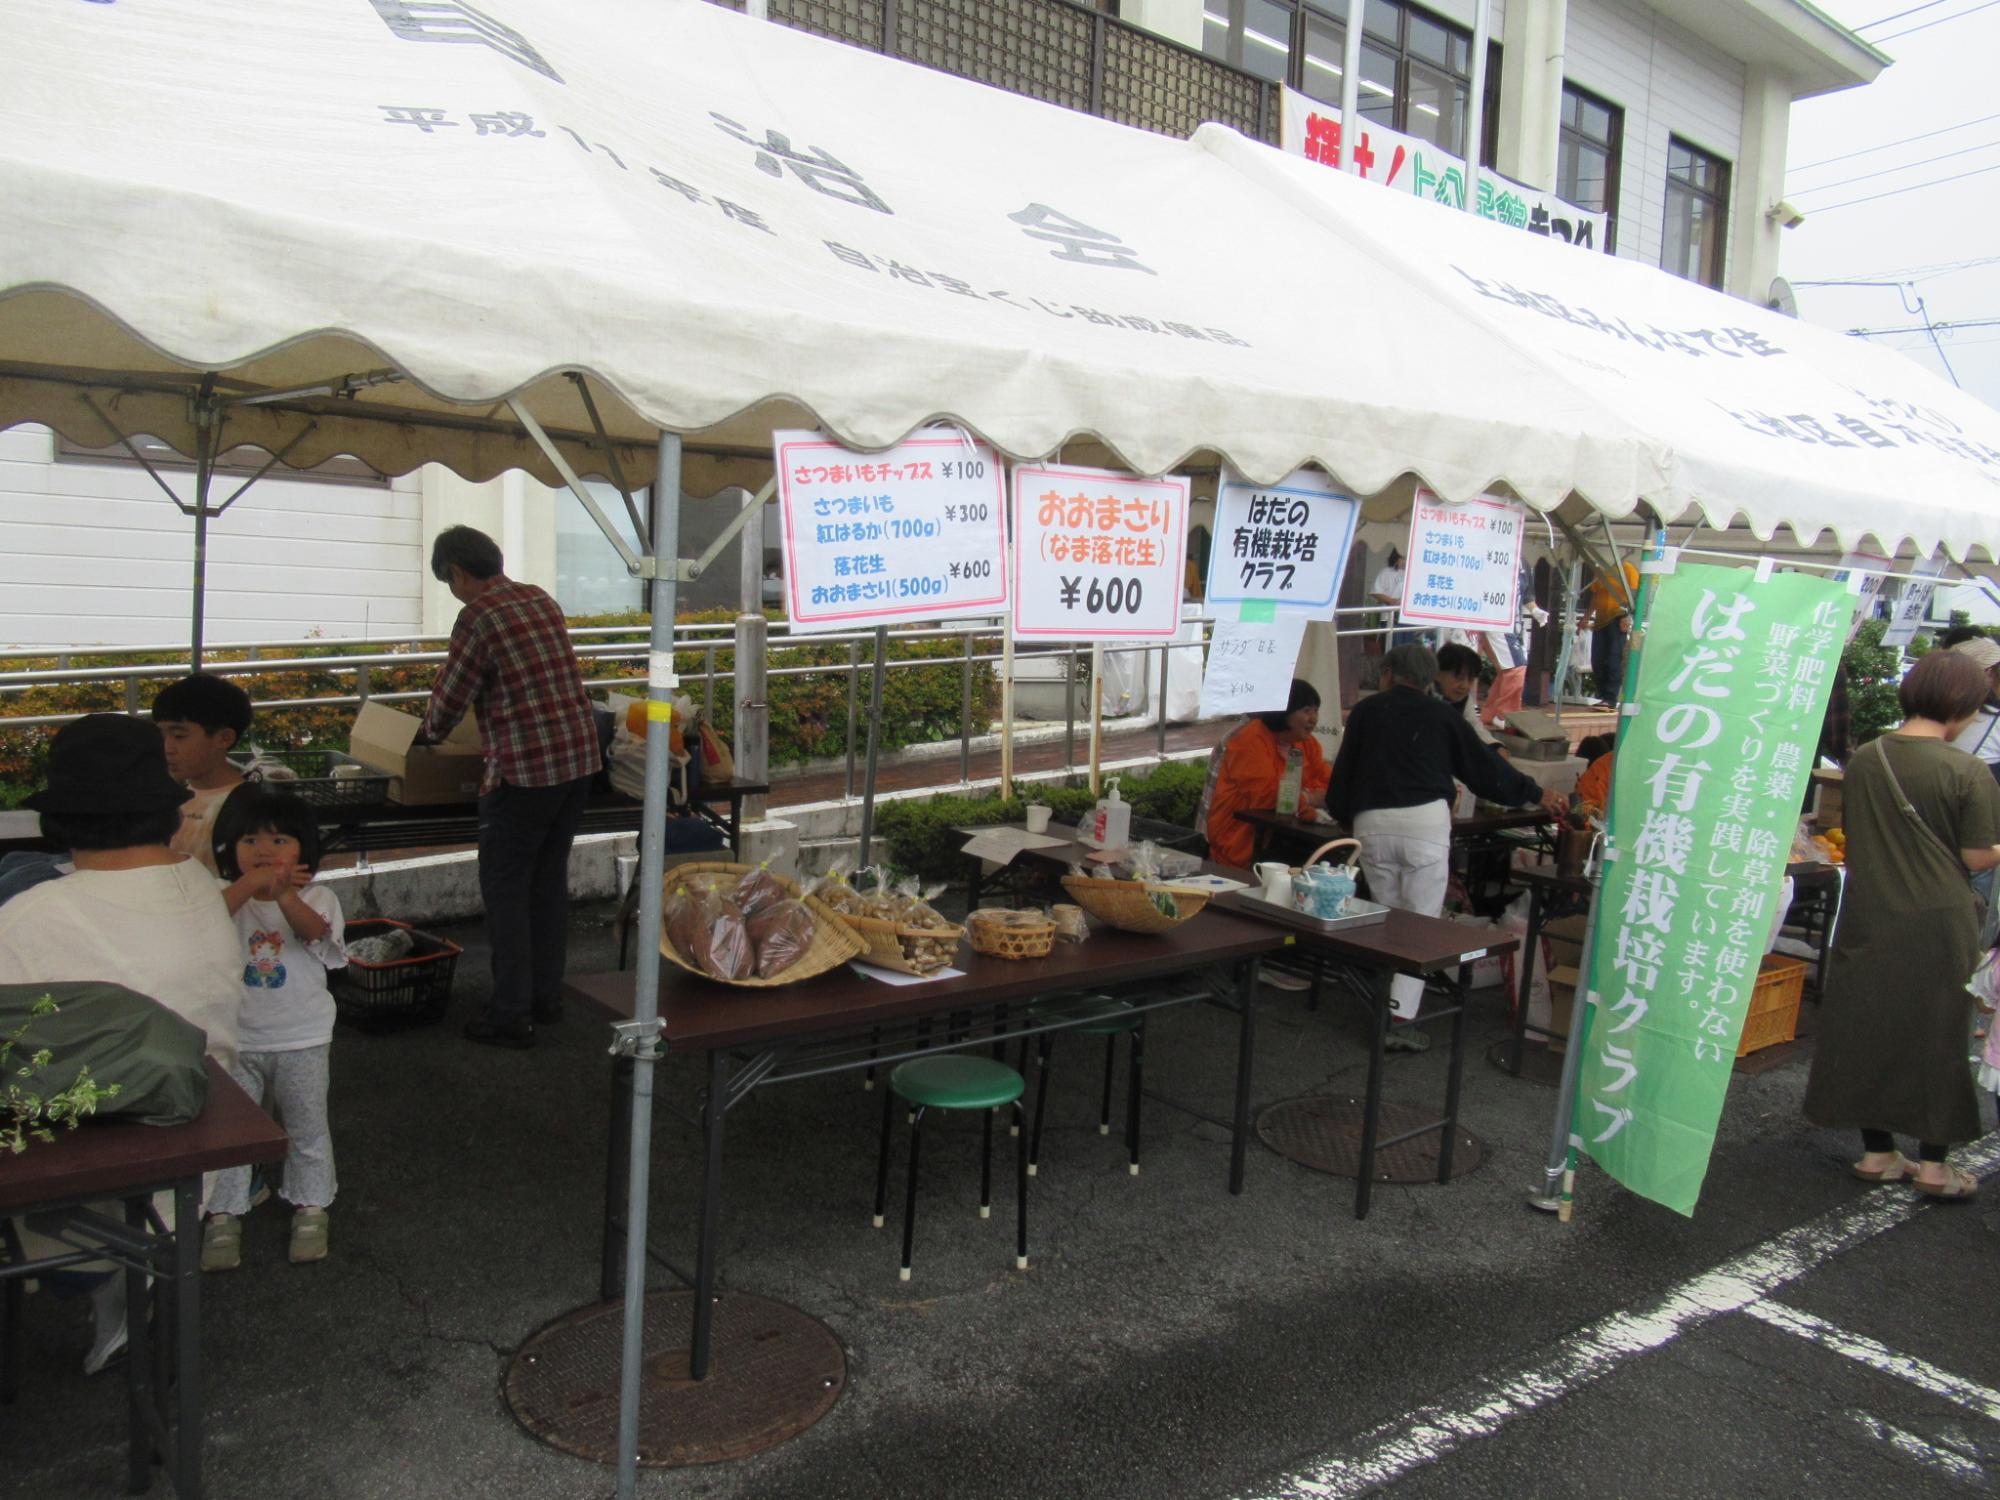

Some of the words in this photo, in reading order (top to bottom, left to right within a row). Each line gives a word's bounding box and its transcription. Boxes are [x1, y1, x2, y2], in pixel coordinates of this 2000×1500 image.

[794, 462, 933, 484] さつまいもチップス
[941, 461, 984, 480] ¥100
[813, 494, 894, 516] さつまいも
[945, 503, 988, 522] ¥300
[1038, 489, 1170, 535] おおまさり
[1248, 494, 1310, 528] はだの
[816, 518, 941, 544] 紅はるか(700g)
[1420, 508, 1486, 530] さつまいもチップス
[1489, 519, 1513, 536] ¥100
[1040, 531, 1166, 568] (なま落花生)
[1233, 526, 1319, 562] 有機栽培
[1425, 531, 1465, 549] さつまいも
[834, 554, 887, 577] 落花生
[949, 559, 991, 579] ¥600
[1487, 550, 1509, 566] ¥300
[811, 574, 949, 605] おおまさり(500g)
[1240, 561, 1296, 591] クラブ
[1427, 574, 1454, 590] 落花生
[1060, 575, 1143, 614] ¥600
[1413, 592, 1482, 612] おおまさり(500g)
[1483, 591, 1506, 607] ¥600
[1676, 622, 1800, 1009] 野菜づくりを実践しています。
[1694, 600, 1841, 1063] 化学肥料・農薬・除草剤を使わない
[1592, 588, 1755, 1143] はだの有機栽培クラブ
